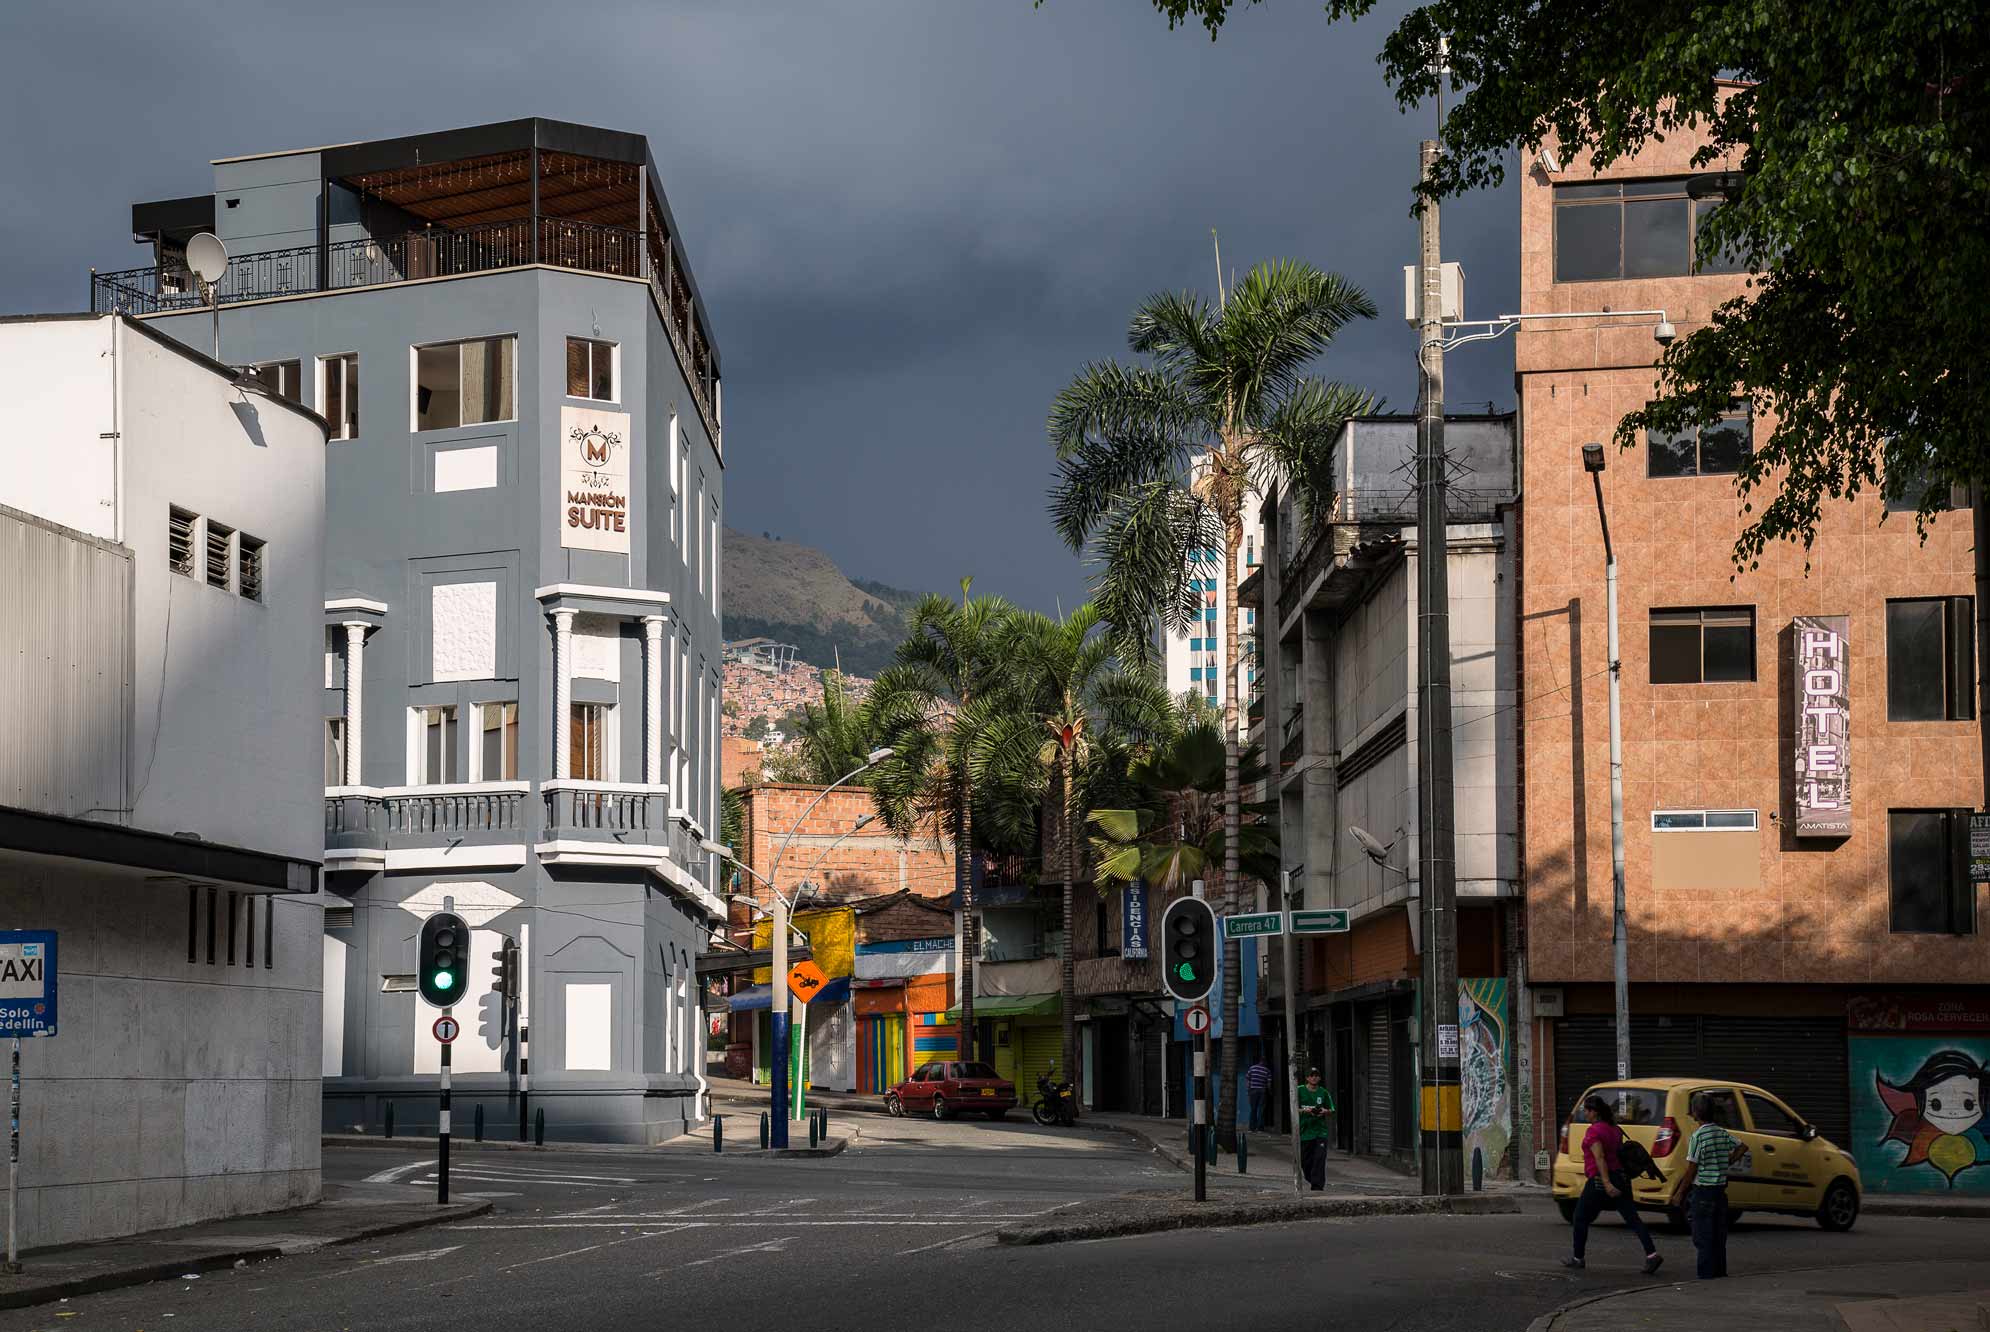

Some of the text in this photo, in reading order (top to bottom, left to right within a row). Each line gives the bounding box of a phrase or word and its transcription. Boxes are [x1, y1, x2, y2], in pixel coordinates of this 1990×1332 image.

[587, 439, 607, 462] M
[567, 490, 626, 509] MANSIÓN
[567, 507, 626, 533] SUITE
[1804, 631, 1842, 810] HOTEL
[1130, 880, 1142, 948] ESIDENCIAS
[1230, 917, 1276, 933] Carrera 47
[913, 940, 925, 951] EL
[0, 959, 43, 982] AXI
[0, 1008, 30, 1019] Solo
[1937, 1002, 1964, 1012] ZONA
[0, 1018, 45, 1030] edellín
[1907, 1012, 1935, 1022] ROSA
